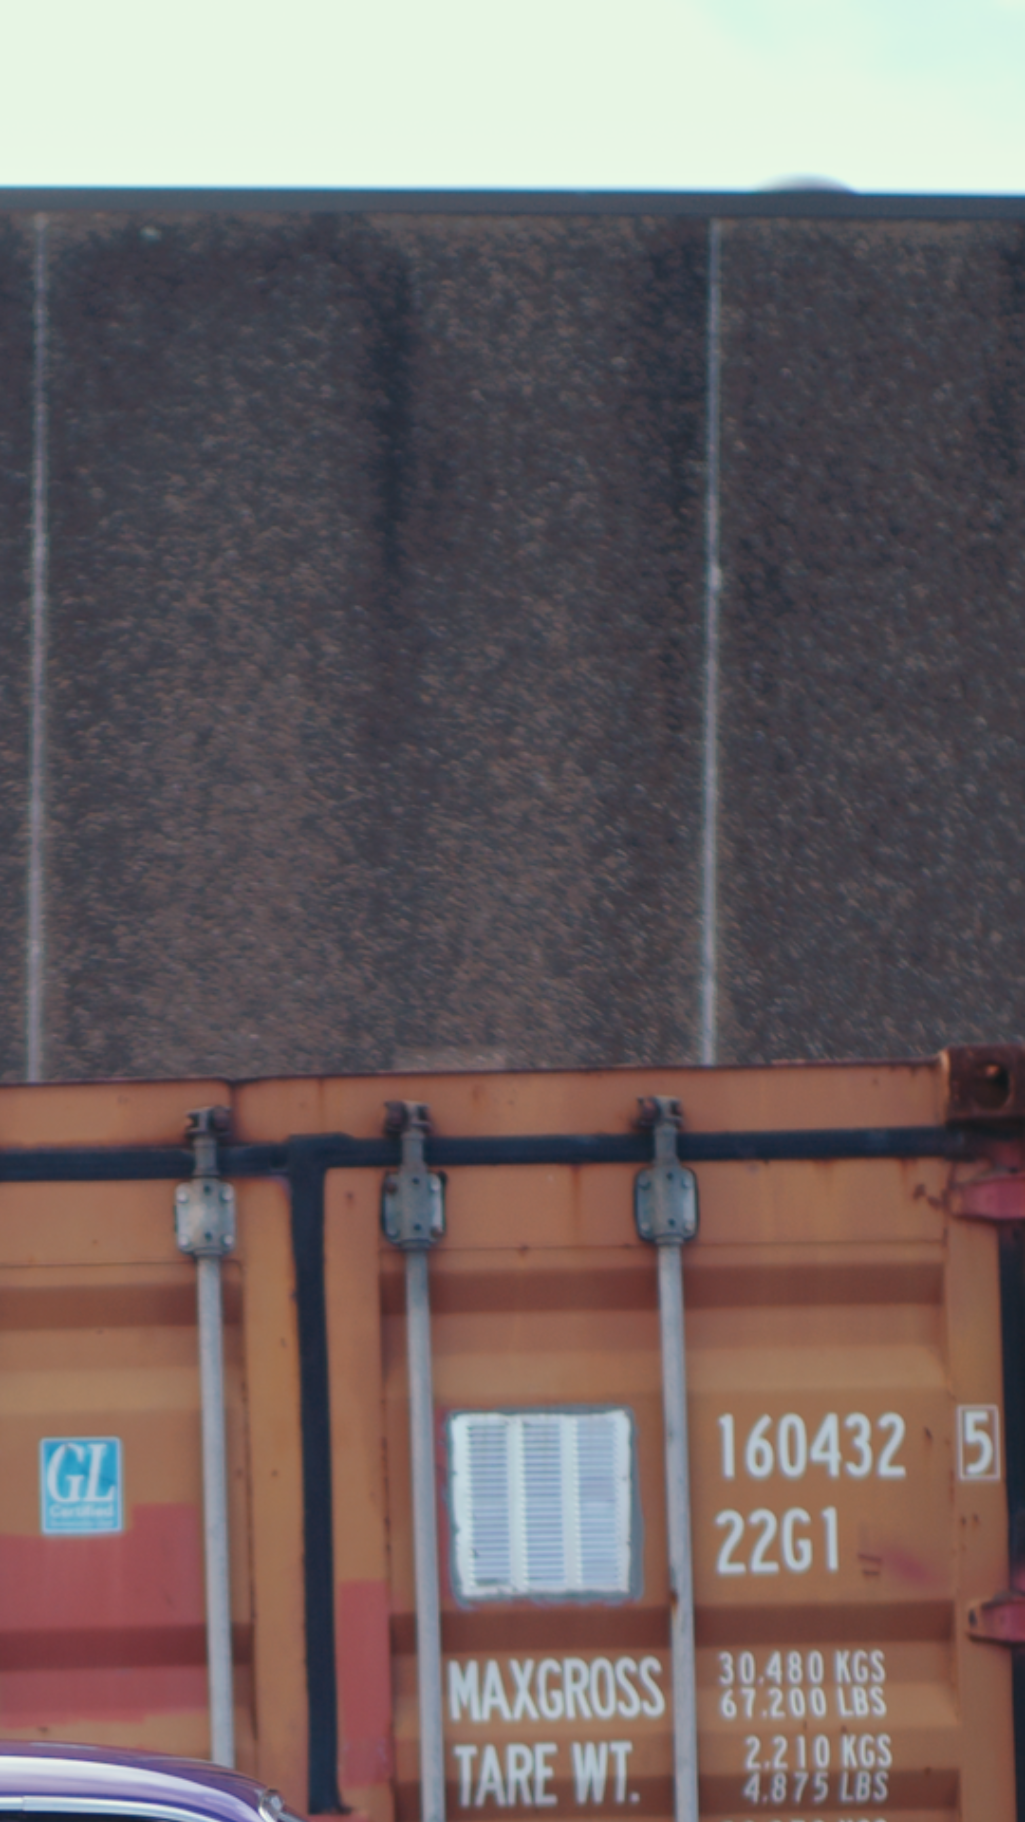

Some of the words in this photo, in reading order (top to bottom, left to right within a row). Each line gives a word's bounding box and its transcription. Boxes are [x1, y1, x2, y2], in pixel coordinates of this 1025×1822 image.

[47, 1442, 116, 1502] GL
[718, 1412, 907, 1479] 160432
[964, 1411, 994, 1475] 5
[714, 1506, 840, 1575] 22G1
[448, 1657, 666, 1722] MAXGROSS
[836, 1650, 887, 1684] KGS
[838, 1686, 887, 1717] LBS
[454, 1743, 558, 1808] TARE
[574, 1741, 641, 1804] WT.
[842, 1734, 893, 1768] KGS
[840, 1771, 889, 1801] LBS
